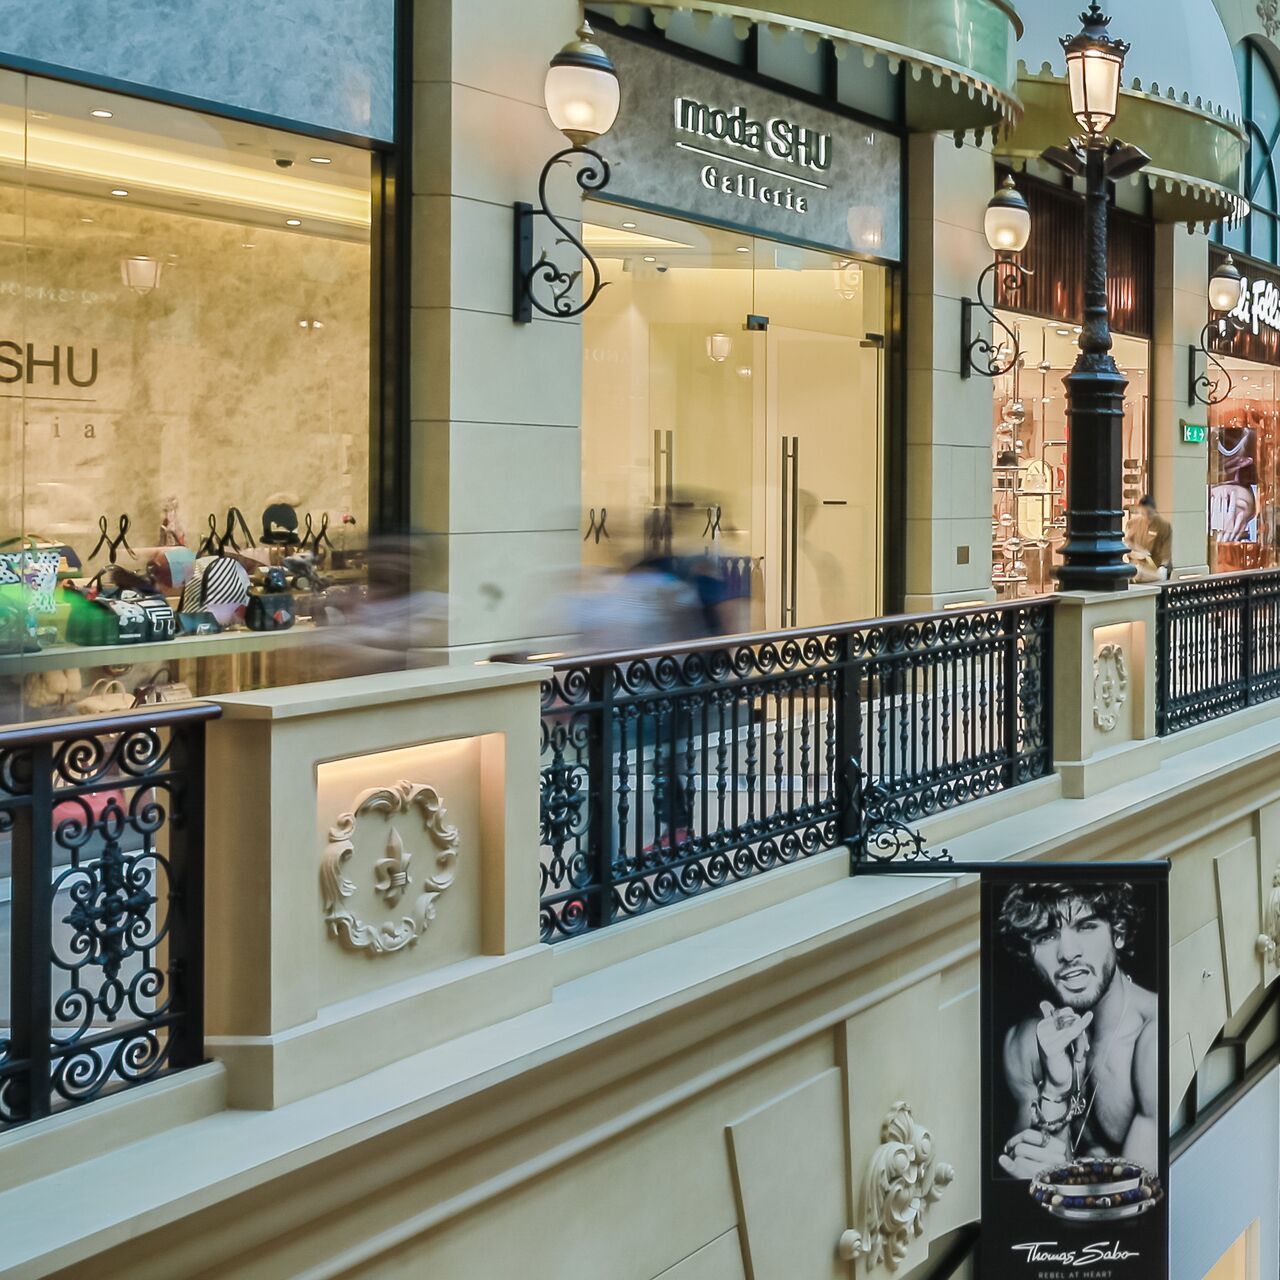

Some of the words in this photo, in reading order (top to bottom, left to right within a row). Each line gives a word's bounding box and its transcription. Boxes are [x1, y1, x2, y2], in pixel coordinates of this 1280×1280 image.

[674, 96, 763, 152] moda
[764, 117, 833, 171] SHU
[700, 165, 809, 214] Galleria
[1011, 1241, 1076, 1265] Thomas
[1072, 1240, 1139, 1266] Sabo
[1038, 1271, 1065, 1280] REBEL
[1069, 1271, 1079, 1279] AT
[1083, 1271, 1112, 1279] HEART
